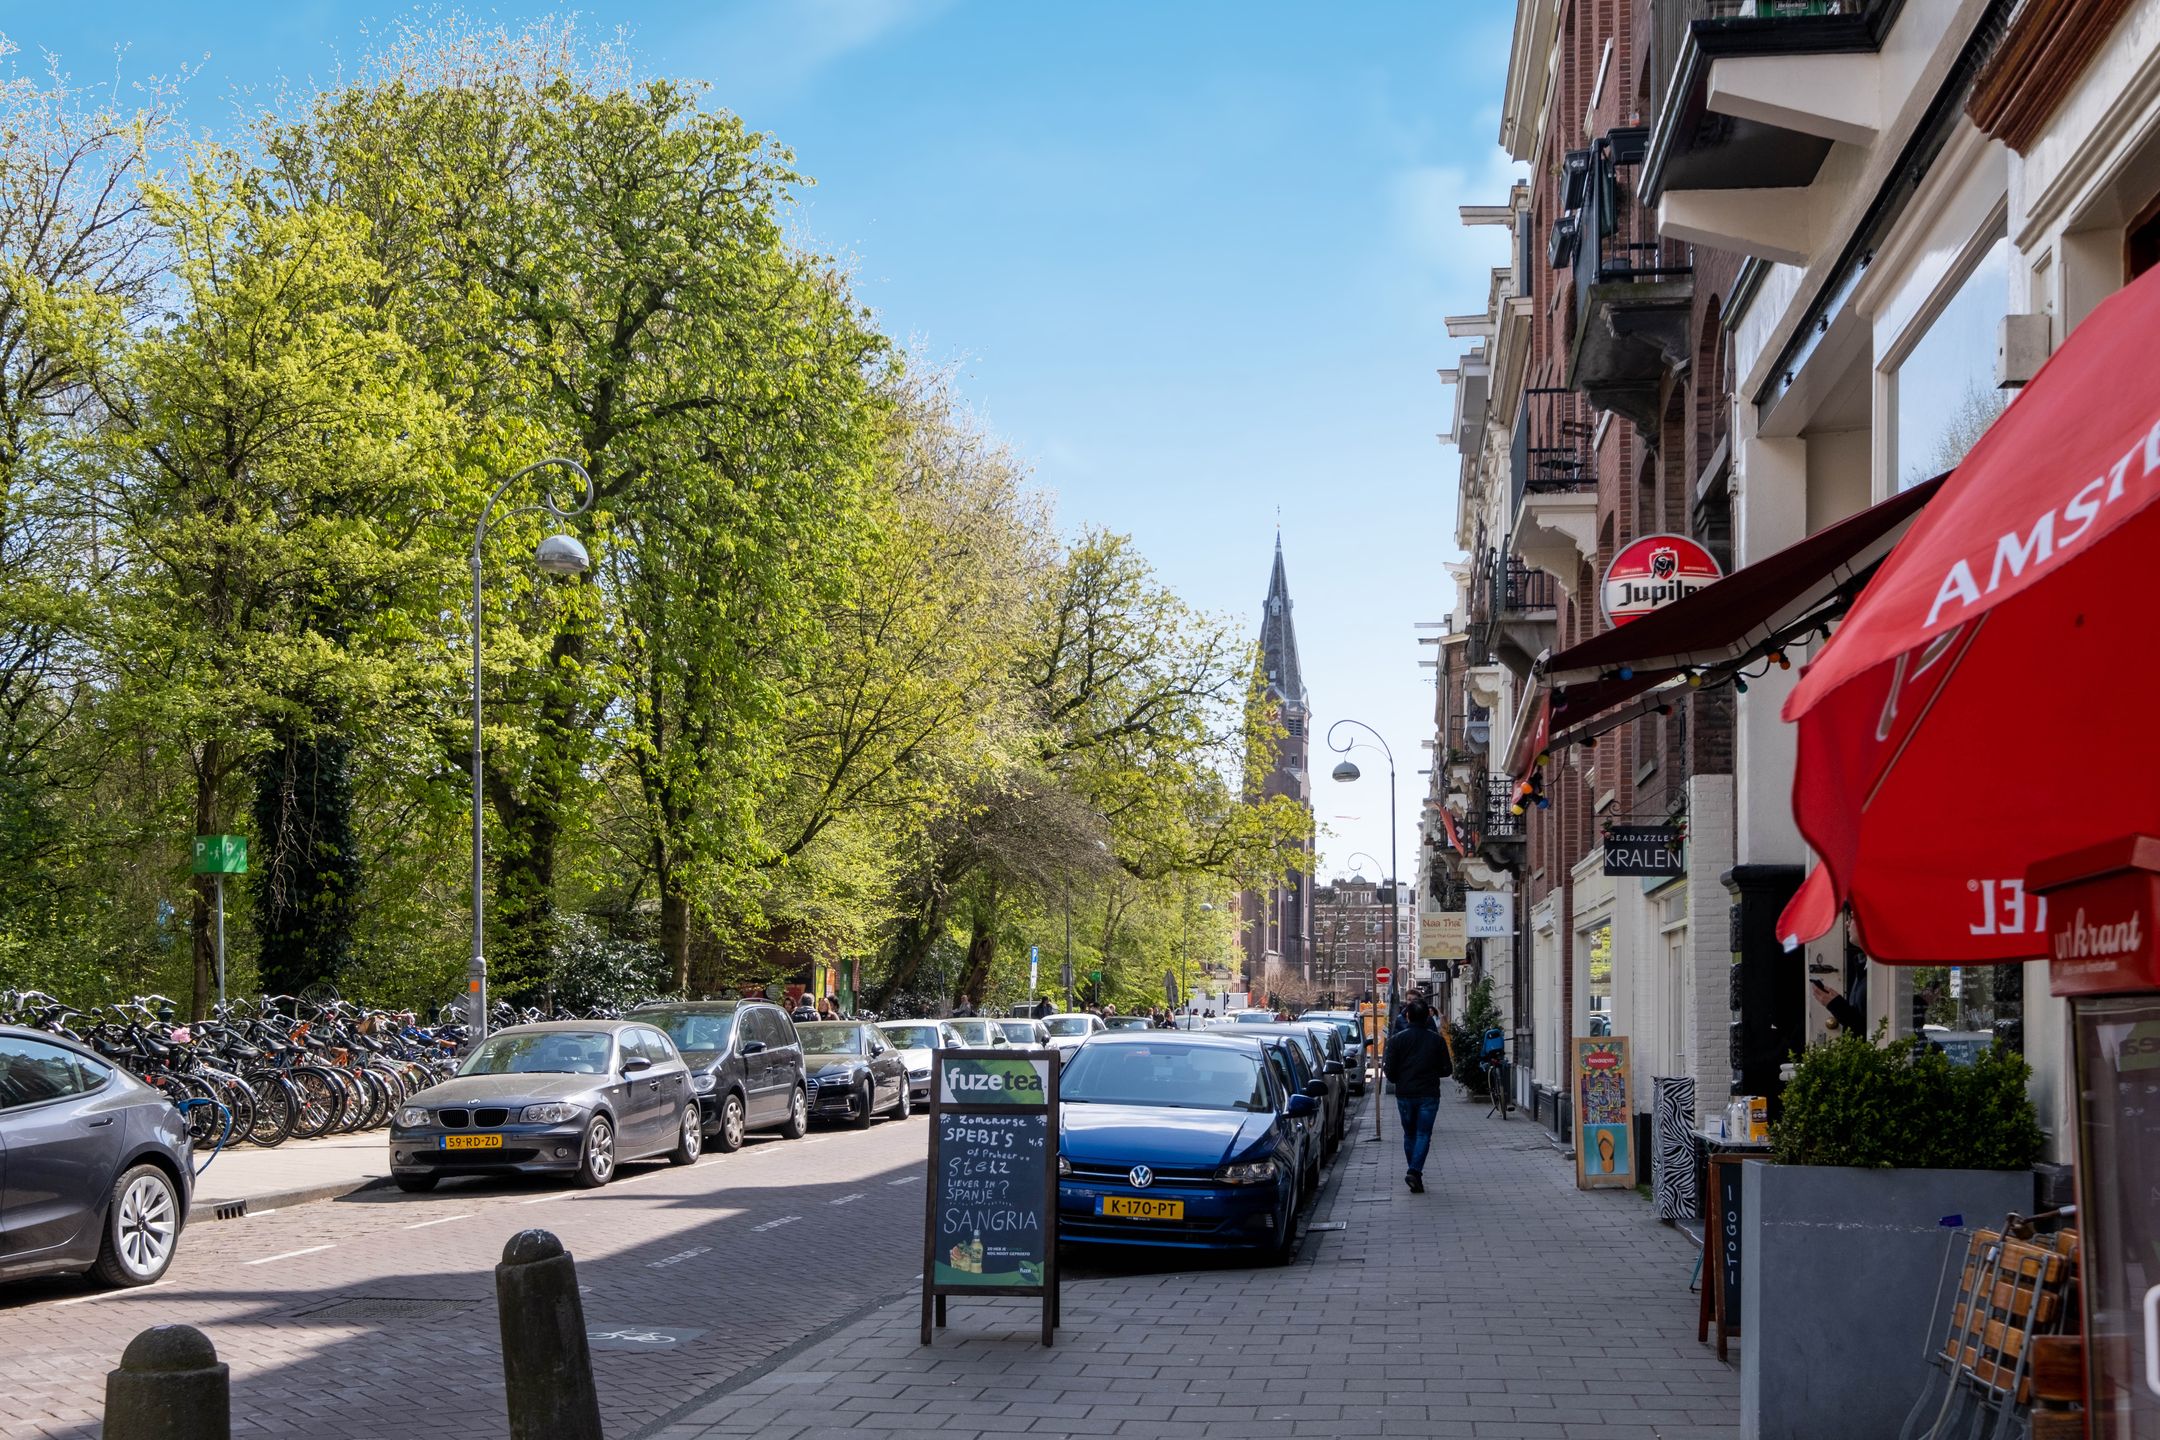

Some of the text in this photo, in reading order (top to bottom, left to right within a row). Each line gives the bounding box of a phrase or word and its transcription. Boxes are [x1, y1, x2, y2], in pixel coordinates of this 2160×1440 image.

[1616, 579, 1706, 608] Jupile
[1609, 834, 1674, 842] EADAZZLE
[1604, 848, 1682, 868] KRALEN
[1475, 925, 1504, 933] SAMILA
[949, 1067, 1042, 1091] fuzetea
[448, 1136, 499, 1148] 59-RD-ZD
[947, 1178, 996, 1189] LIEVER IN
[945, 1187, 993, 1205] SPANJE
[1111, 1199, 1177, 1217] K-170-PT
[943, 1207, 1038, 1234] SANGRIA
